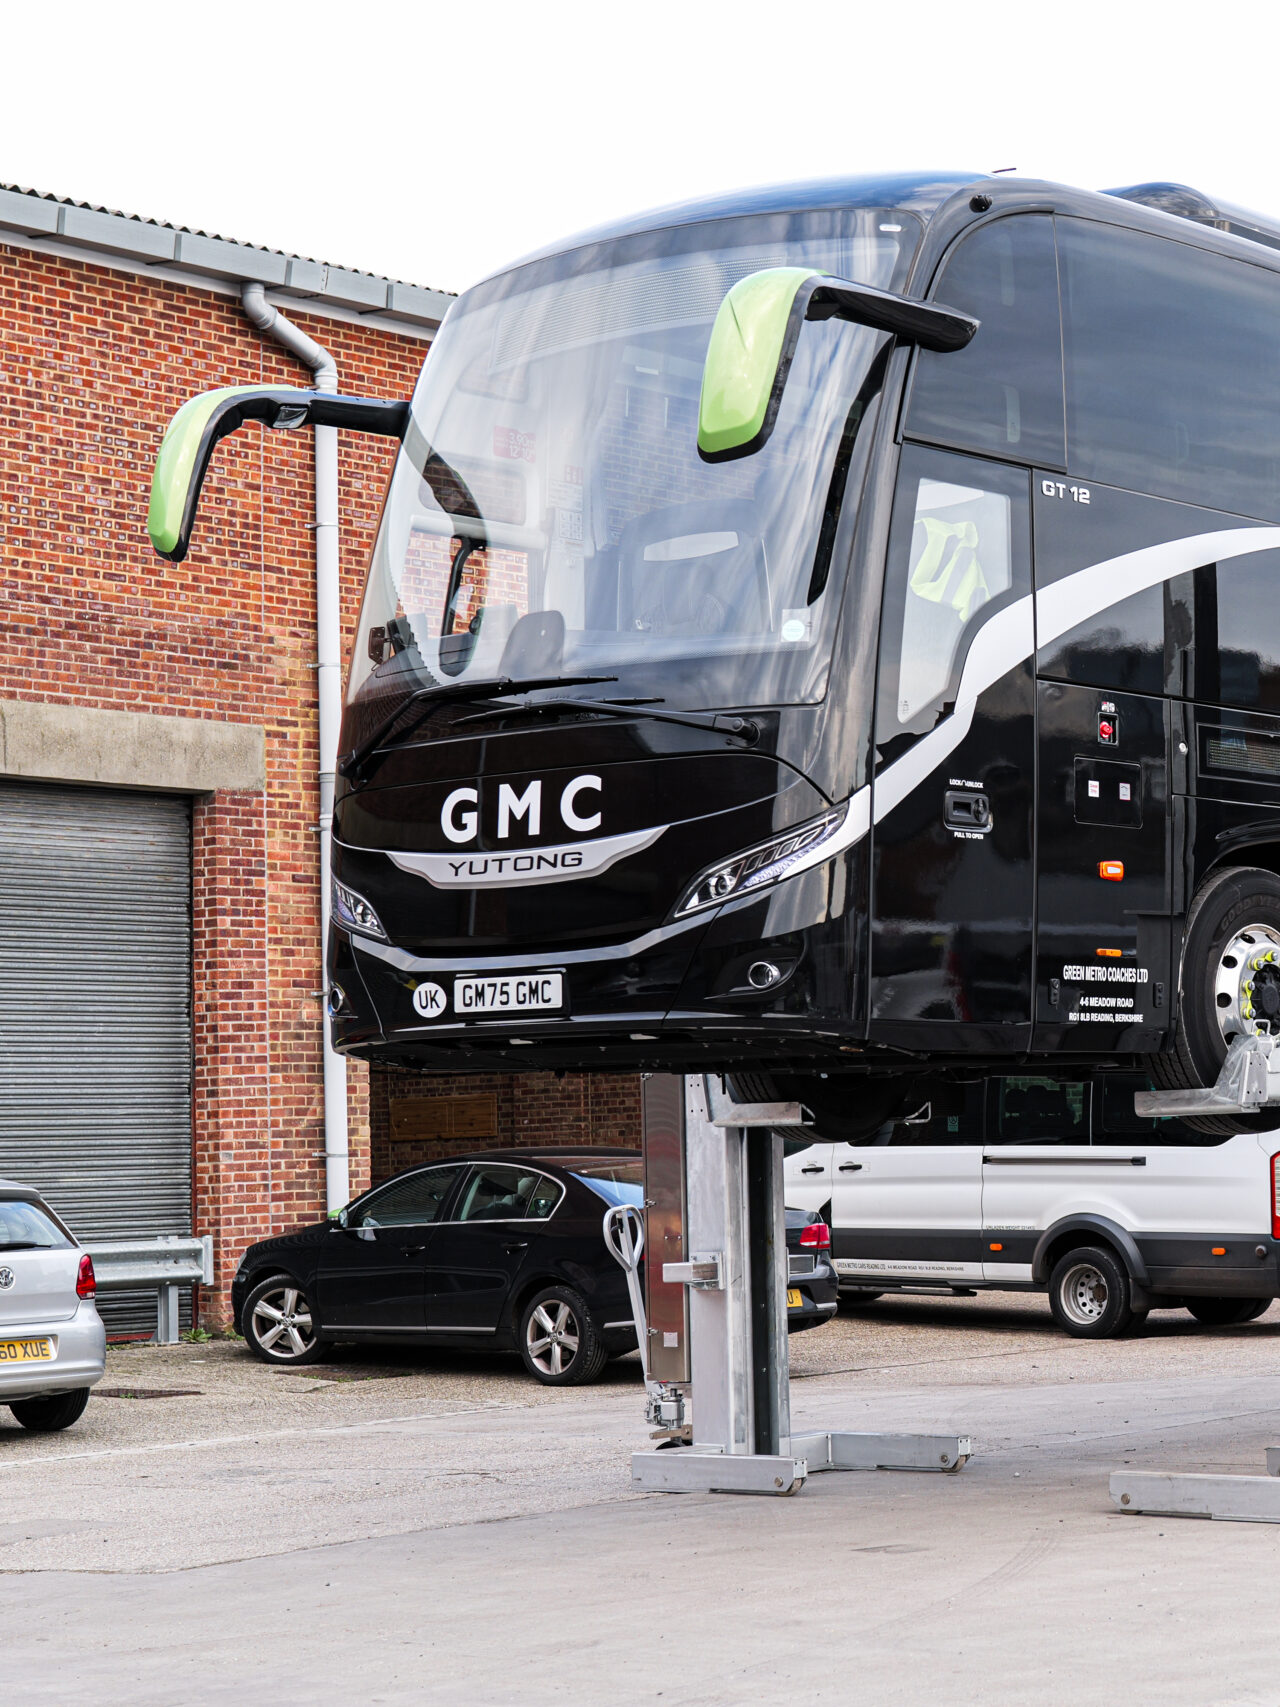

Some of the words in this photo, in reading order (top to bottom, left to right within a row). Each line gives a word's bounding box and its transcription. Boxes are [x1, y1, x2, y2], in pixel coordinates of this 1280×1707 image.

[1042, 480, 1066, 499] GT
[1069, 486, 1090, 504] 12
[441, 774, 602, 843] GMC
[448, 852, 583, 877] YUTONG
[1063, 965, 1085, 981] GREEN
[1085, 966, 1107, 982] METRO
[1107, 967, 1137, 983] COACHES
[1137, 968, 1149, 983] LTD
[418, 990, 440, 1009] UK
[462, 982, 510, 1007] GM75
[516, 980, 552, 1005] GMC
[1080, 996, 1089, 1007] 4-6
[1090, 997, 1116, 1007] MEADOW
[1116, 998, 1134, 1008] ROAD
[1090, 1013, 1115, 1023] READING,
[1115, 1014, 1144, 1023] BERKSHIRE
[20, 1341, 50, 1358] XUE
